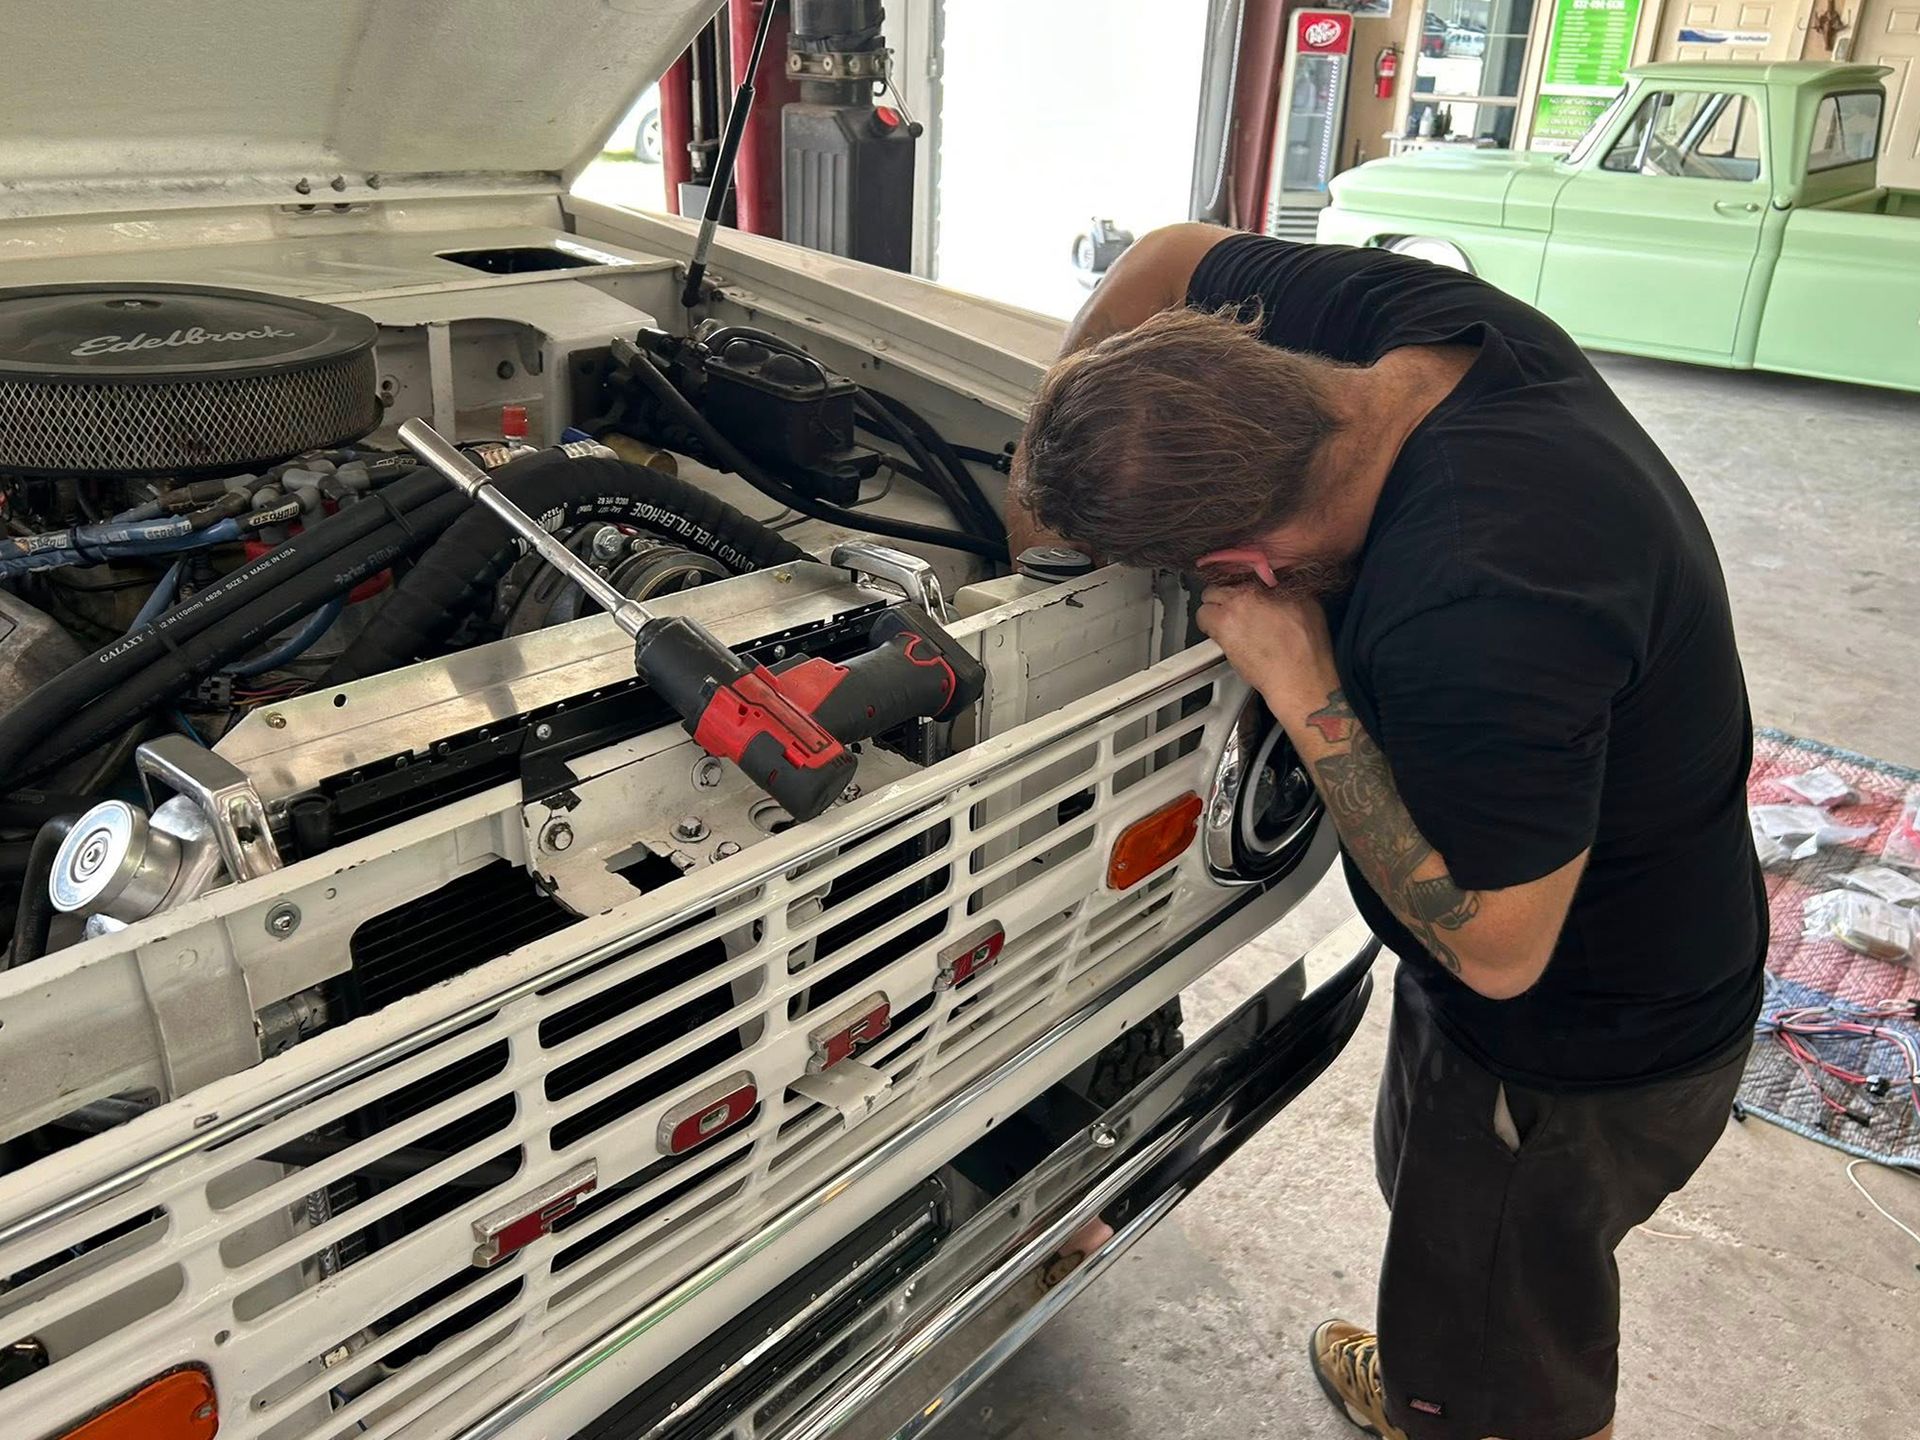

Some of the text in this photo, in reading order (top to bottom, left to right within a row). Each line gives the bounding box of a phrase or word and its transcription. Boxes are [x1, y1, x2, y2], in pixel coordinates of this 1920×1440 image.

[70, 325, 296, 358] Edelbrock
[629, 502, 663, 522] HOSE
[718, 544, 755, 573] DAYCO
[99, 634, 144, 663] GALAXY
[176, 601, 204, 620] (10mm)
[225, 577, 243, 591] SIZE
[249, 560, 272, 575] MADE
[271, 555, 280, 564] IN
[280, 547, 296, 559] USA
[472, 919, 1005, 1268] FORD
